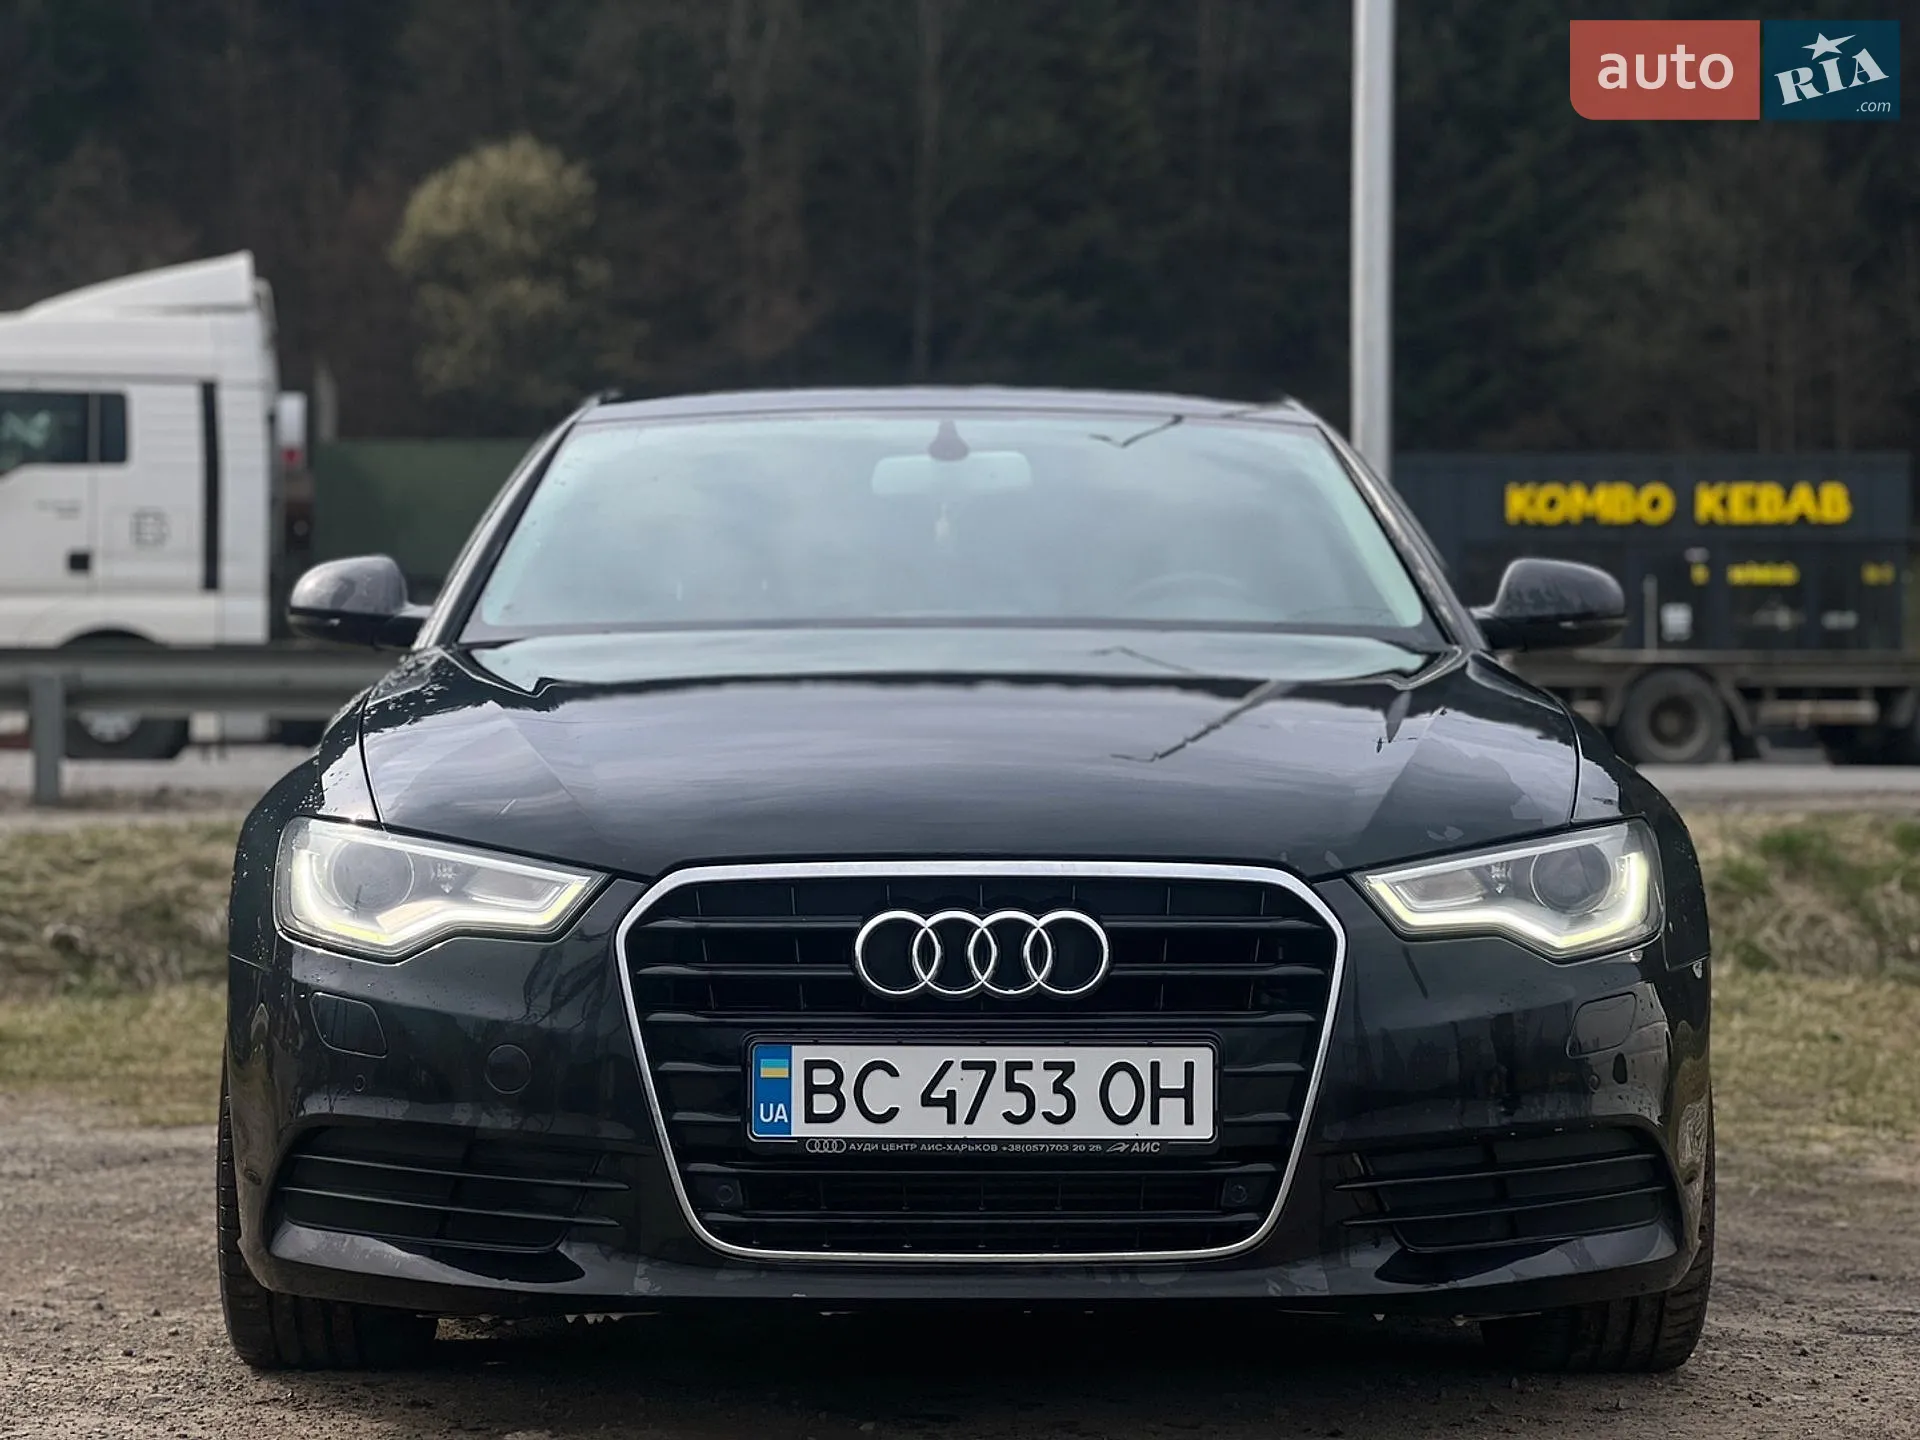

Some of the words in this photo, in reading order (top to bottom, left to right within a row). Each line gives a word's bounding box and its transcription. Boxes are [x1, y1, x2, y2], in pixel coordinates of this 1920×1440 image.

[1505, 482, 1675, 525] KOMBO
[1694, 481, 1852, 524] KEBAB
[803, 1058, 900, 1125] BC
[920, 1059, 1076, 1125] 4753
[1099, 1060, 1195, 1126] OH
[759, 1104, 788, 1123] UA
[849, 1143, 878, 1152] АУДИ
[881, 1143, 917, 1153] ЦЕНТР
[920, 1143, 998, 1152] АИС-ХАРЬКОВ
[1130, 1142, 1160, 1153] АИС
